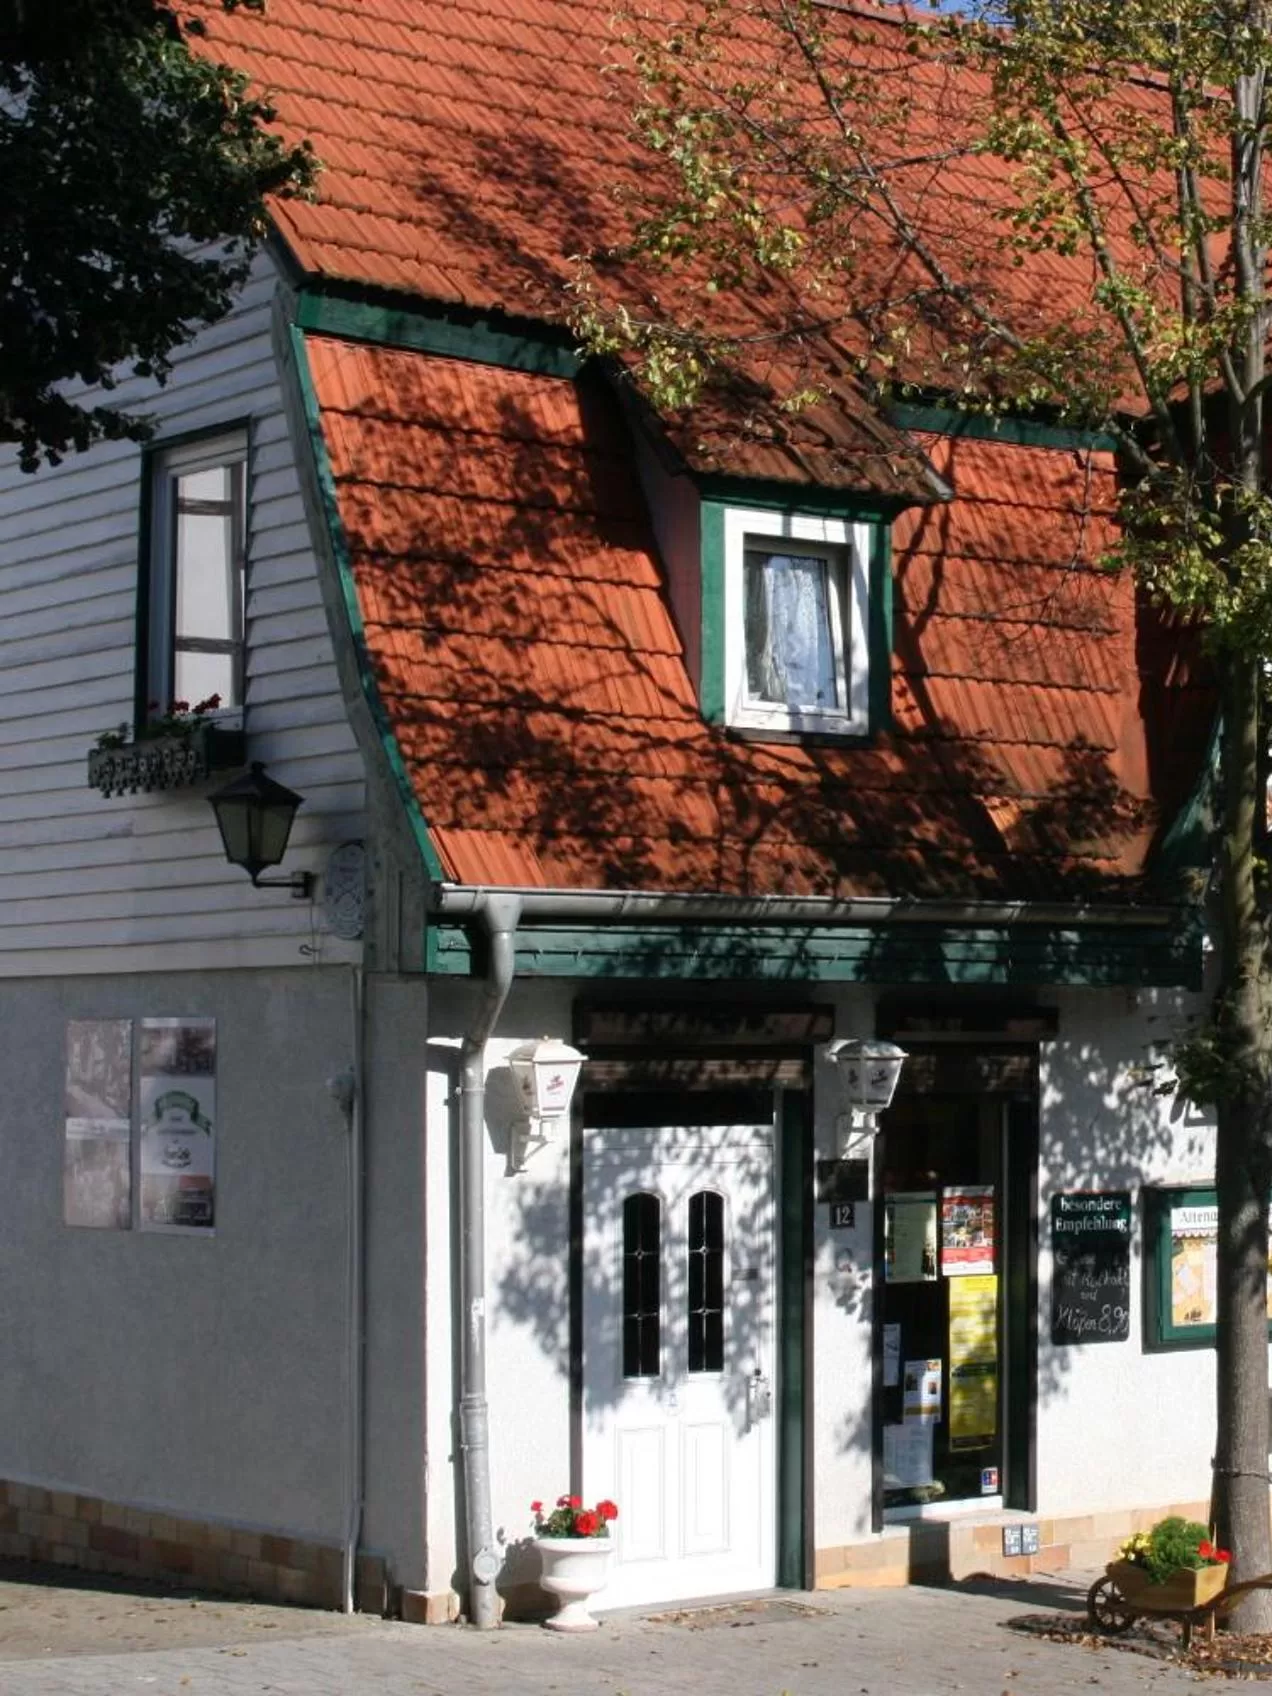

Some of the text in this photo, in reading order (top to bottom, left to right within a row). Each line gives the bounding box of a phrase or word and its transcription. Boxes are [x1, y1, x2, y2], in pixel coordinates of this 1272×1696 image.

[1060, 1196, 1122, 1212] besondere
[836, 1206, 851, 1225] 12
[1055, 1215, 1128, 1236] Empfehlung
